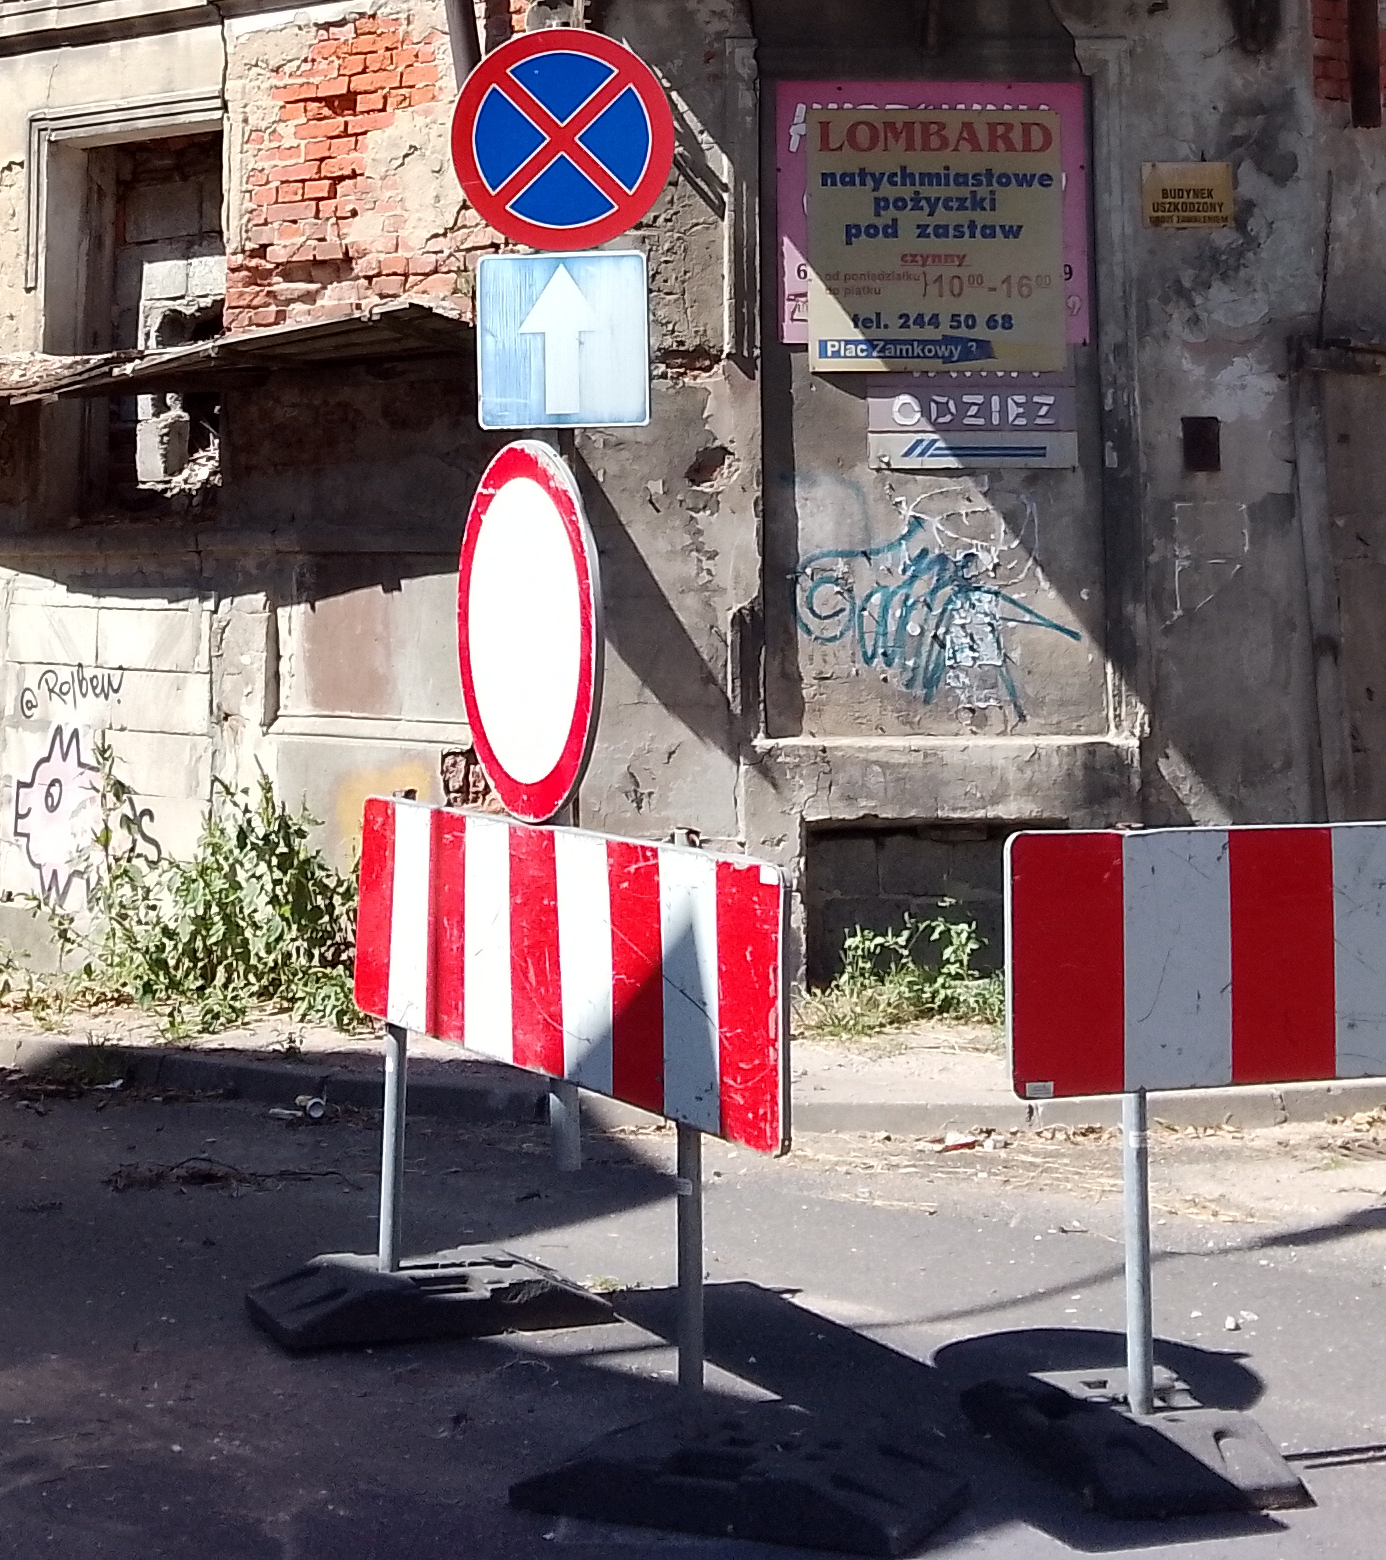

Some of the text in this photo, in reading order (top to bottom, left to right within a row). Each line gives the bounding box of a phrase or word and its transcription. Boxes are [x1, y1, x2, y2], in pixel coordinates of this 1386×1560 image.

[818, 121, 1053, 152] LOMBARD
[820, 165, 1053, 191] natychmiastowe
[873, 190, 996, 216] pożyczki
[1161, 188, 1214, 199] BUDYNEK
[1152, 201, 1224, 213] USZKODZONY
[845, 218, 1023, 244] pod zastaw
[900, 253, 967, 267] czynny
[825, 271, 840, 281] od
[851, 312, 1014, 330] tel. 244 50 68
[826, 342, 868, 357] Plac
[872, 341, 962, 361] Zamkowy
[892, 393, 1056, 426] ODZIEZ
